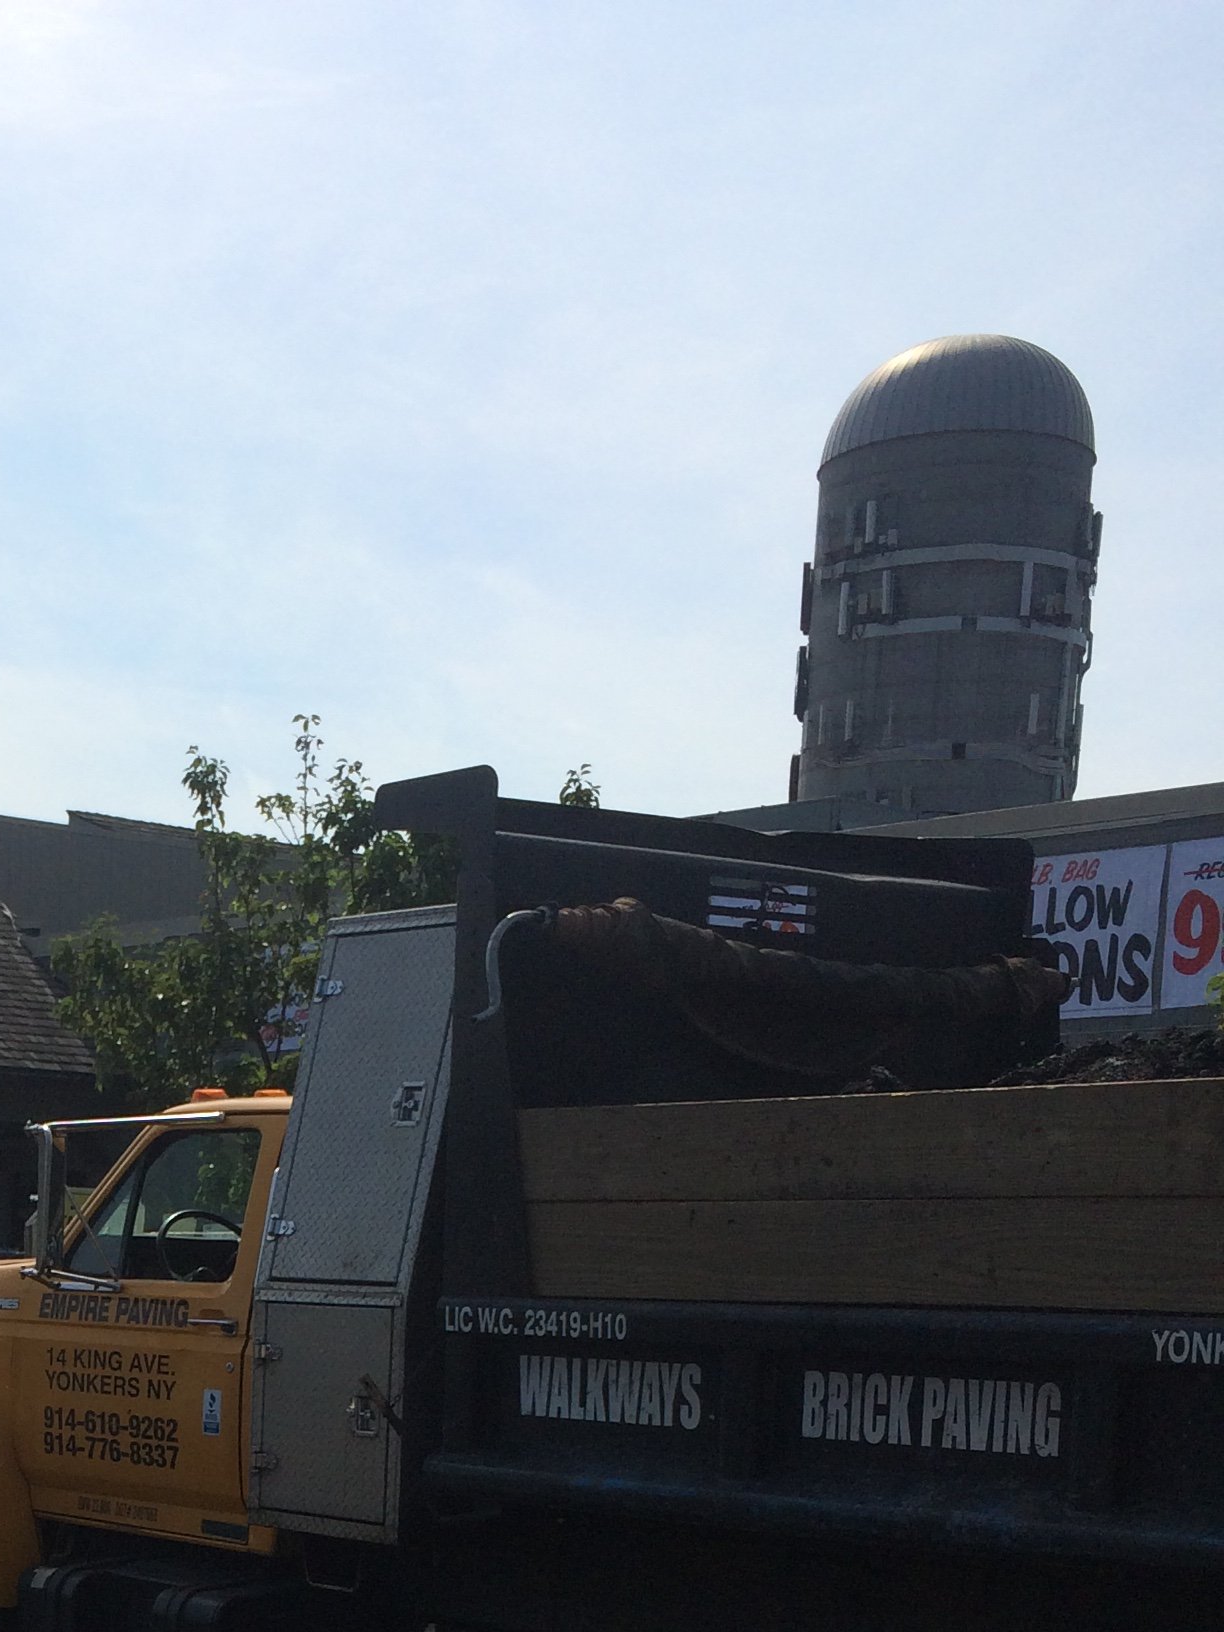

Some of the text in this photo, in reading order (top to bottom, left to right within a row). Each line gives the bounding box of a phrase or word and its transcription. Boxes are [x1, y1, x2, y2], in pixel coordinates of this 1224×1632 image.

[1061, 858, 1101, 883] BAG
[39, 1293, 189, 1328] EMPIRE PAVING
[445, 1305, 627, 1340] LIC W.C. 23419-H10
[47, 1347, 176, 1376] 14 KING AVE.
[45, 1369, 176, 1400] YONKERS NY
[519, 1355, 701, 1430] WALKWAYS
[44, 1405, 178, 1443] 914-610-9262
[801, 1370, 1062, 1458] BRICK PAVING
[43, 1432, 179, 1470] 914-776-8337
